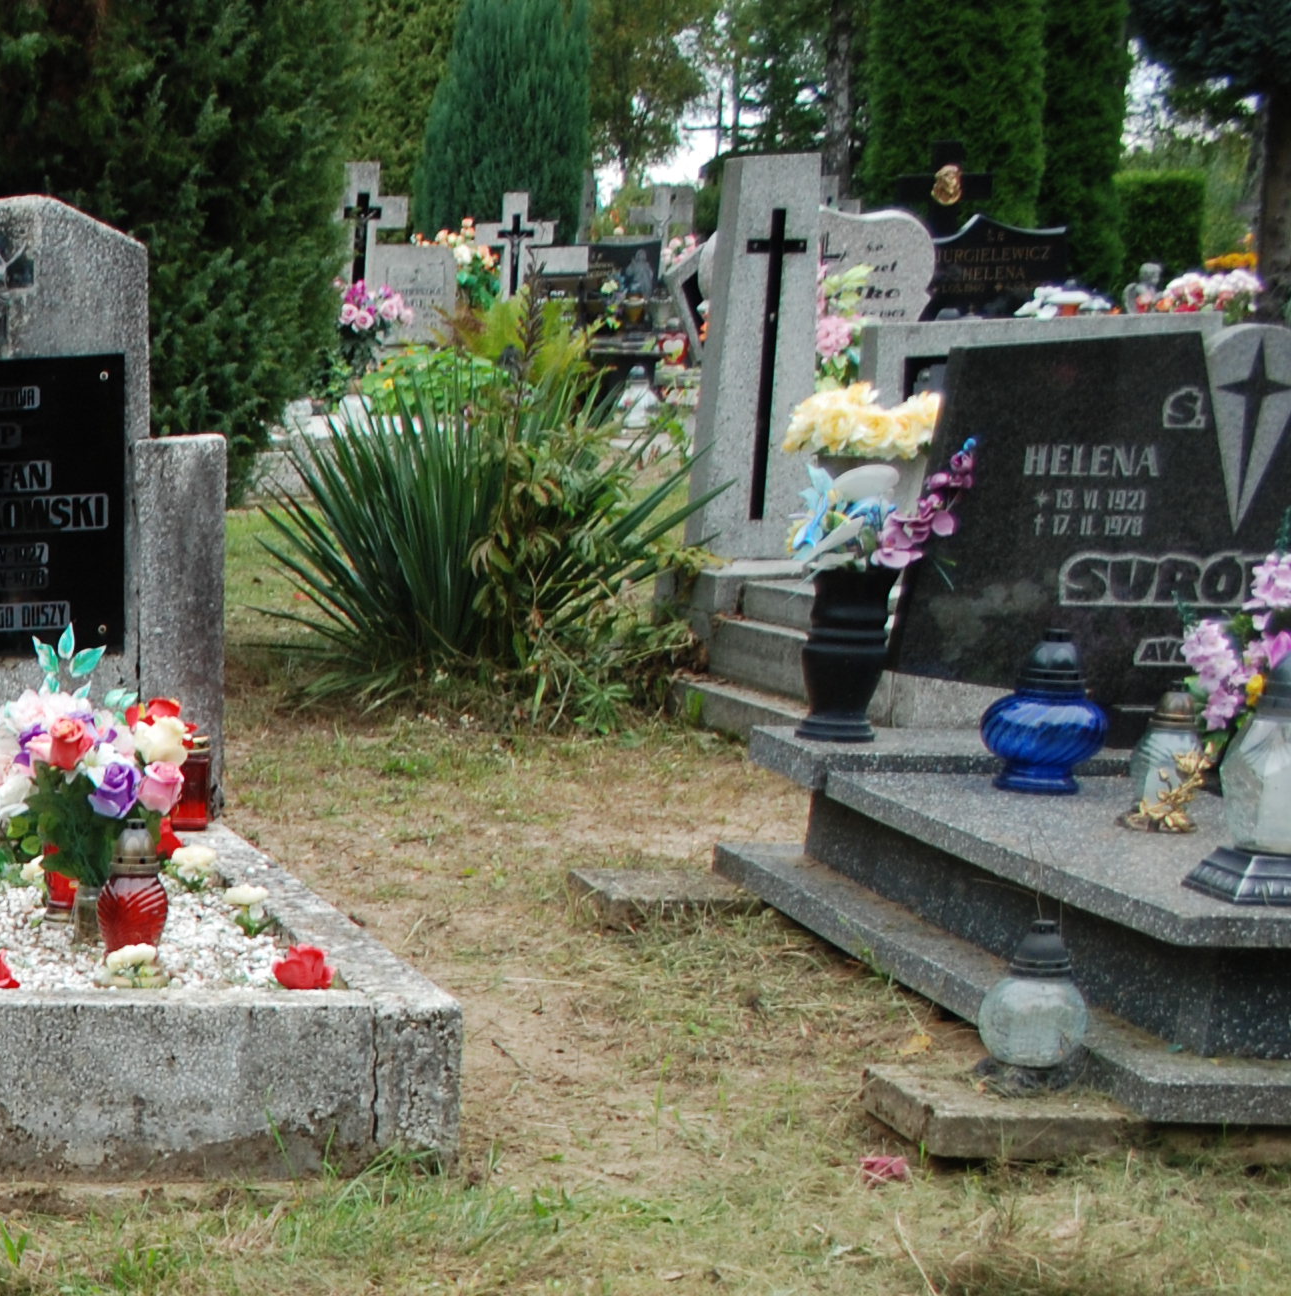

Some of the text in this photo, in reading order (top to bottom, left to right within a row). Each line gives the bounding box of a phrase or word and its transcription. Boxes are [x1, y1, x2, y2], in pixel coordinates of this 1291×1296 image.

[1022, 444, 1160, 478] HELENA
[1107, 488, 1146, 510] 1921
[1103, 515, 1143, 536] 1978
[21, 603, 67, 628] DUSZY
